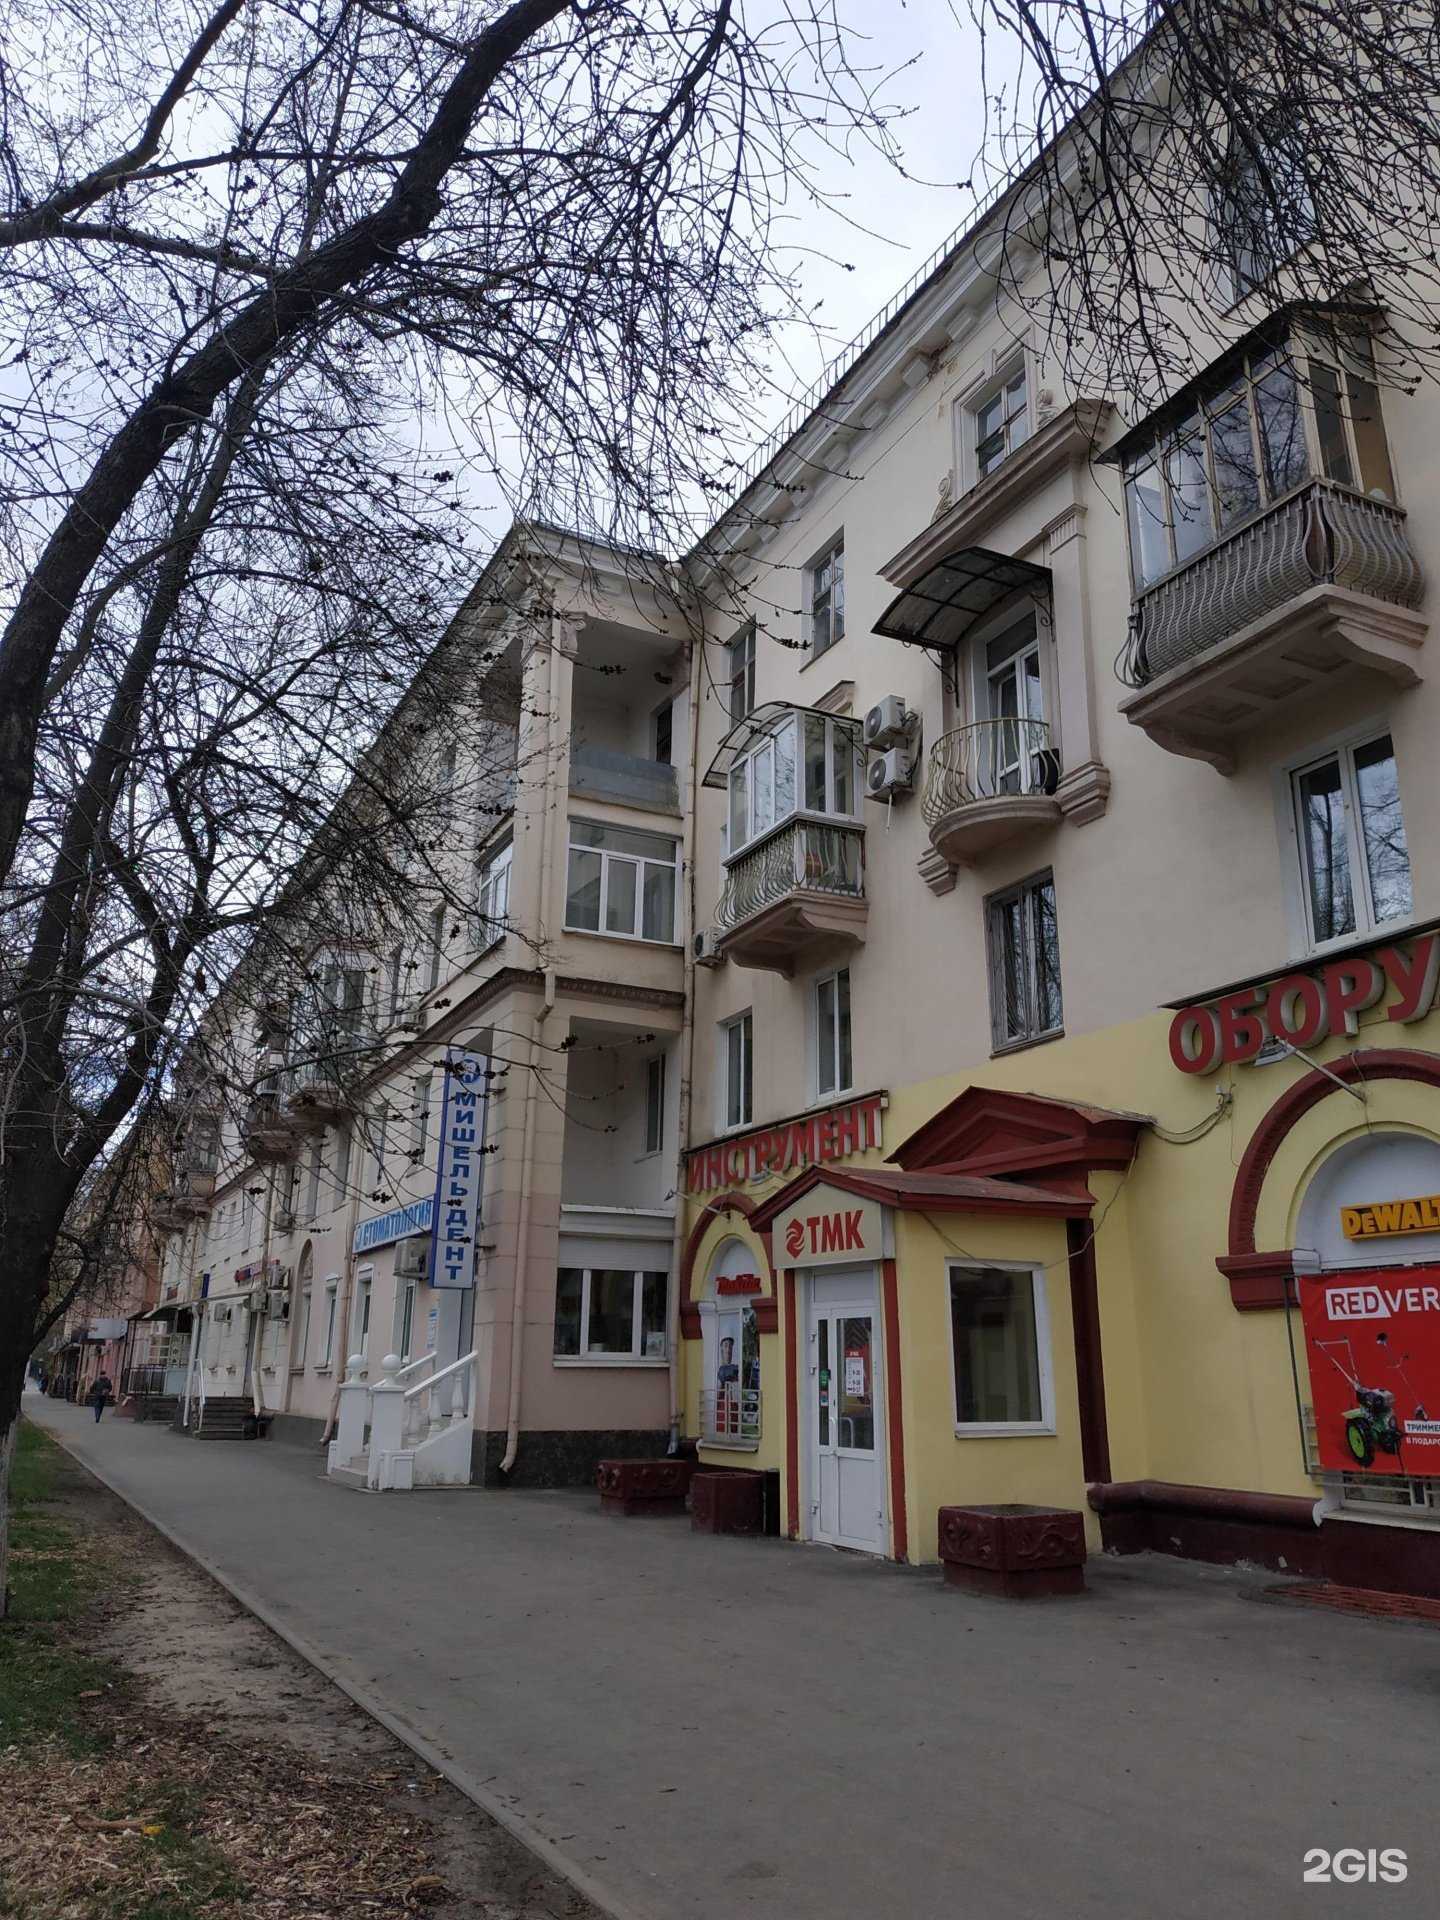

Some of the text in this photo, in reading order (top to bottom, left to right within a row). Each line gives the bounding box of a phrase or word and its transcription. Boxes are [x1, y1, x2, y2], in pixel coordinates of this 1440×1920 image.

[1169, 936, 1438, 1075] ОБОРУ
[445, 1091, 476, 1281] МИШЕЛЬ ДЕНТ
[687, 1095, 882, 1193] ИНСТРУМЕНТ
[806, 1209, 865, 1254] ТМК
